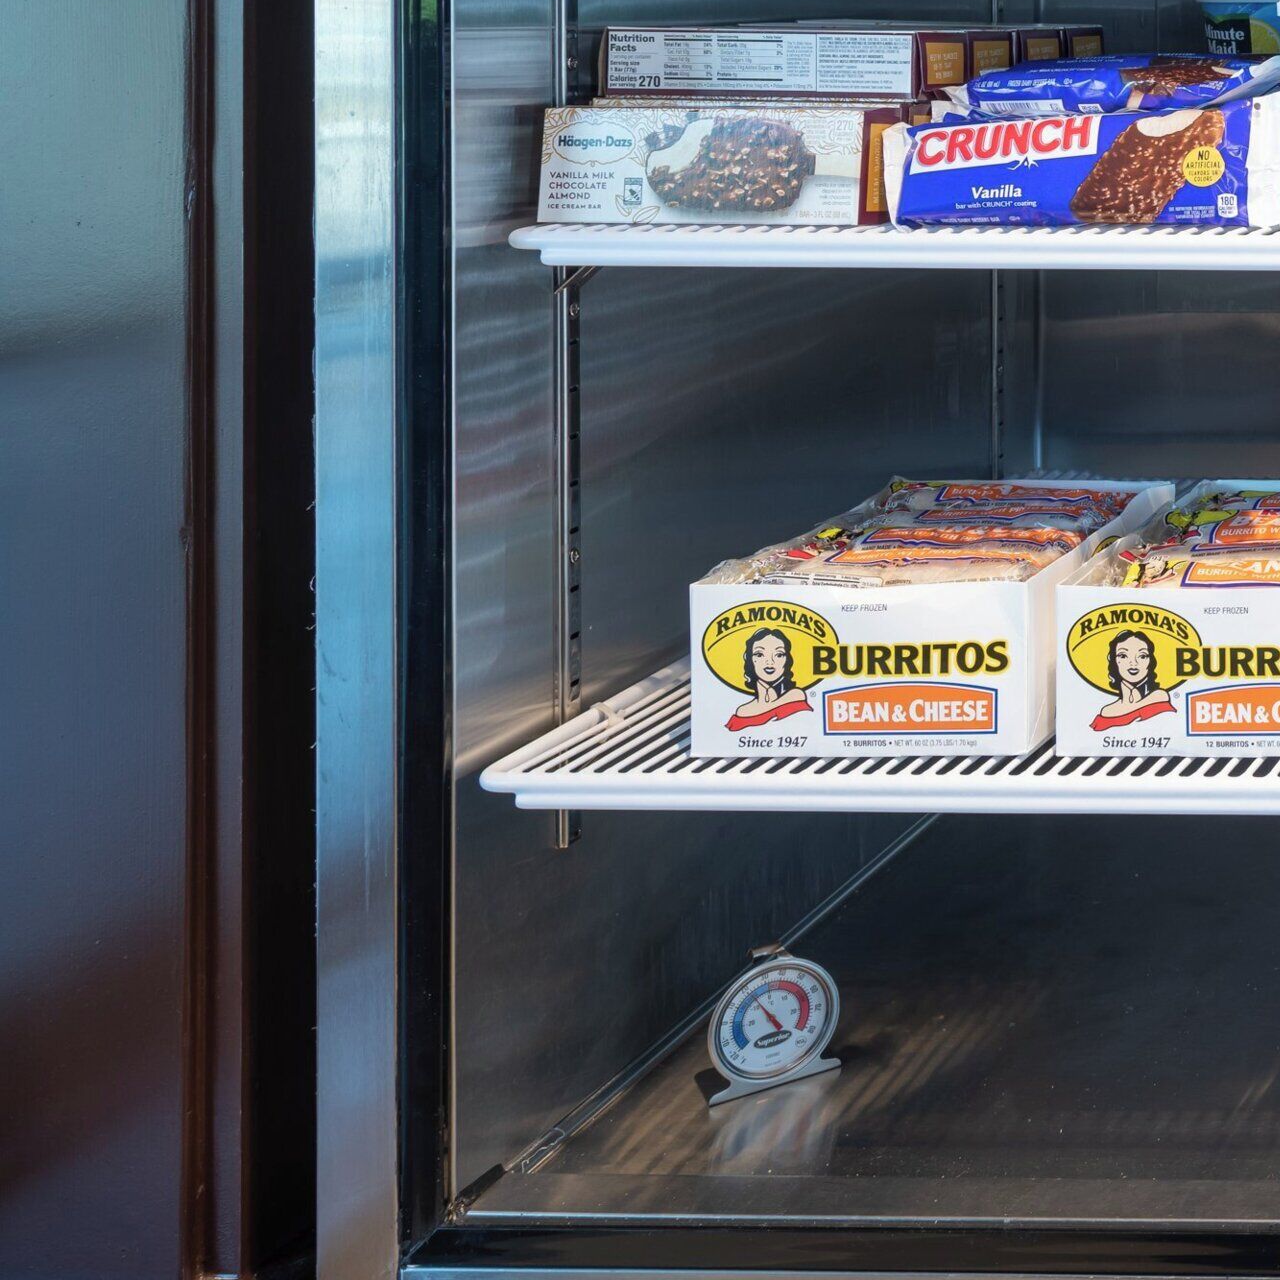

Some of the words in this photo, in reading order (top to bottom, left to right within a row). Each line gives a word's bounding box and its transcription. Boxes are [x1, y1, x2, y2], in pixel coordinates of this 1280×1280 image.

[610, 34, 655, 43] Nutrition
[610, 43, 637, 52] Facts
[610, 75, 637, 83] Calories
[639, 75, 661, 88] 270
[917, 116, 1094, 166] CRUNCH
[1198, 150, 1209, 161] NO
[549, 171, 588, 180] VANILLA
[592, 172, 615, 180] MILK
[549, 181, 607, 190] CHOCOLATE
[548, 192, 591, 200] ALMOND
[971, 185, 1022, 200] Vanilla
[982, 200, 1010, 208] CRUNCH
[1014, 200, 1037, 209] coating
[841, 604, 858, 612] KEEP
[860, 603, 888, 612] FROZEN
[716, 606, 827, 640] RAMONA'S
[1079, 609, 1189, 640] RAMONA'S
[812, 641, 1009, 676] BURRITOS
[833, 699, 889, 723] BEAN
[892, 706, 906, 723] &
[909, 698, 987, 722] CHEESE
[1196, 701, 1252, 724] BEAN
[1254, 708, 1269, 723] &
[738, 735, 773, 749] Since
[777, 735, 807, 749] 1947
